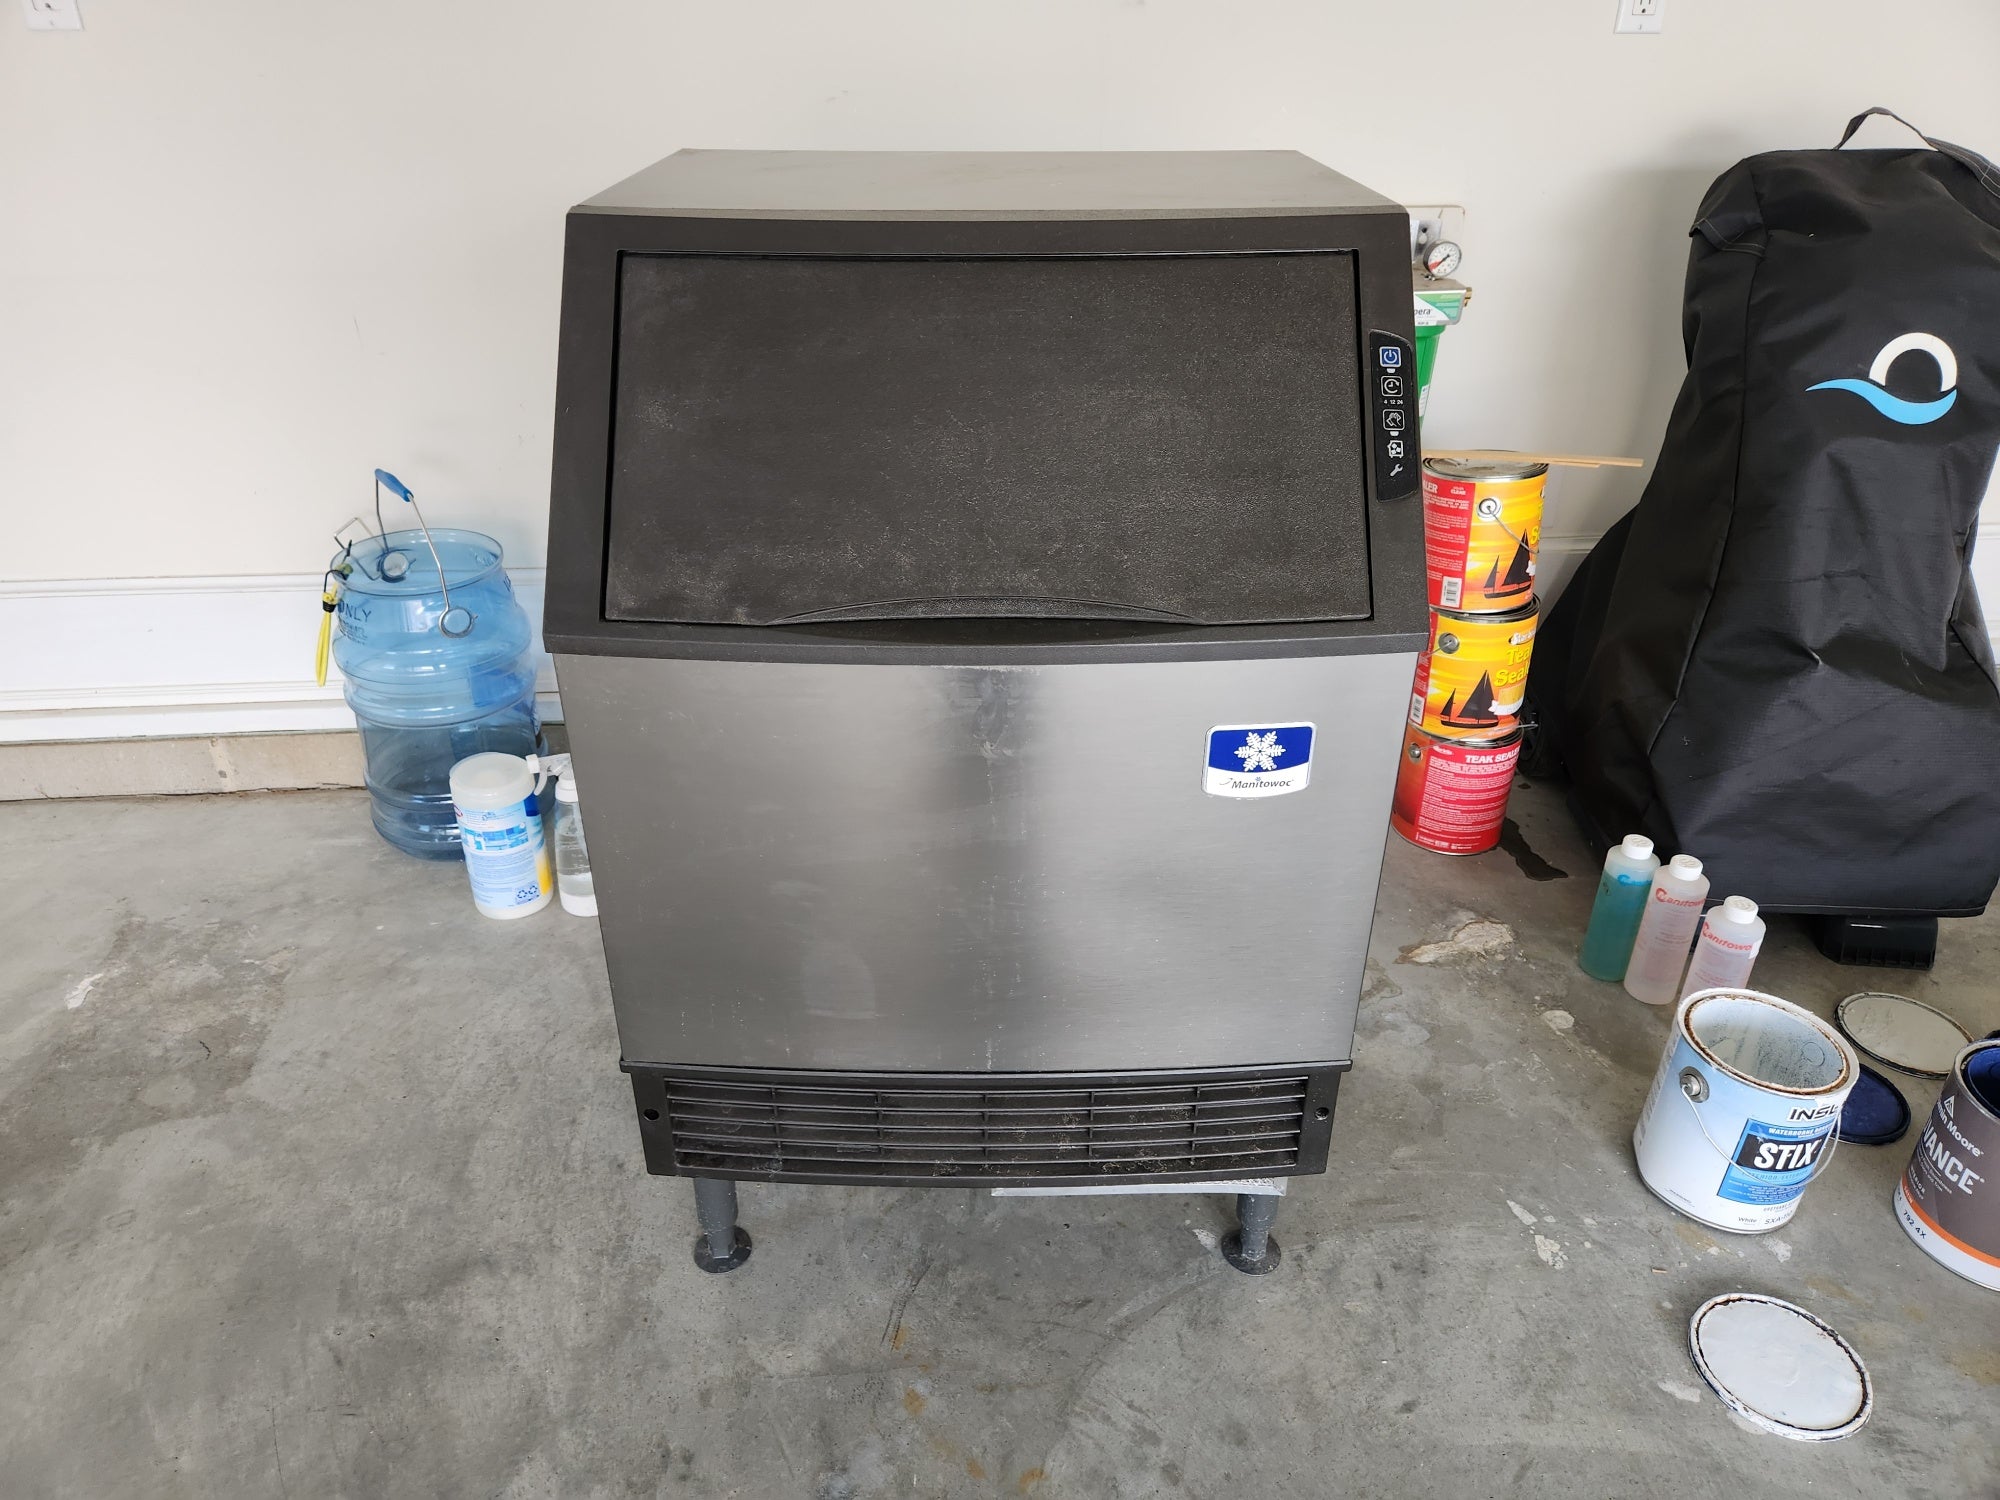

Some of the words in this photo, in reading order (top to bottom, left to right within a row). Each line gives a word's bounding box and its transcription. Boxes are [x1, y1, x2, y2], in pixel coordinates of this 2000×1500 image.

[1506, 647, 1532, 665] Tea
[1494, 661, 1529, 687] Seal
[1465, 755, 1494, 763] TEAK
[1231, 779, 1292, 789] Manitowoc
[1947, 1120, 1981, 1157] Moore
[1753, 1139, 1822, 1170] STIX
